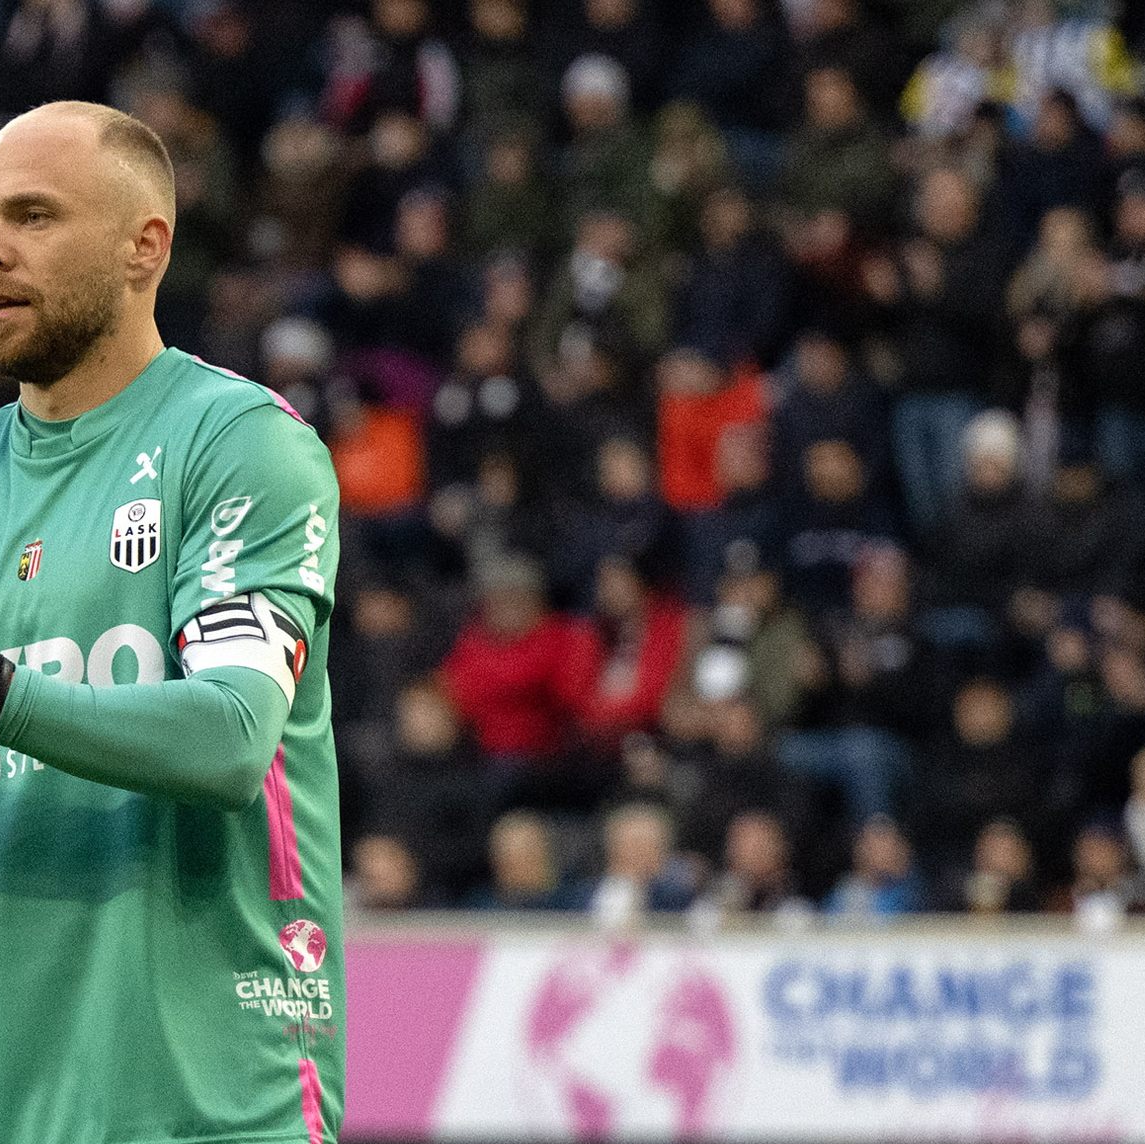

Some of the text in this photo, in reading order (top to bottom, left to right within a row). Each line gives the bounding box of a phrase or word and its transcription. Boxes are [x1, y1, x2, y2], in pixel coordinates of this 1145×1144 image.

[115, 523, 157, 538] LASK
[236, 978, 331, 1000] CHANGE
[239, 999, 333, 1020] THE WORLD
